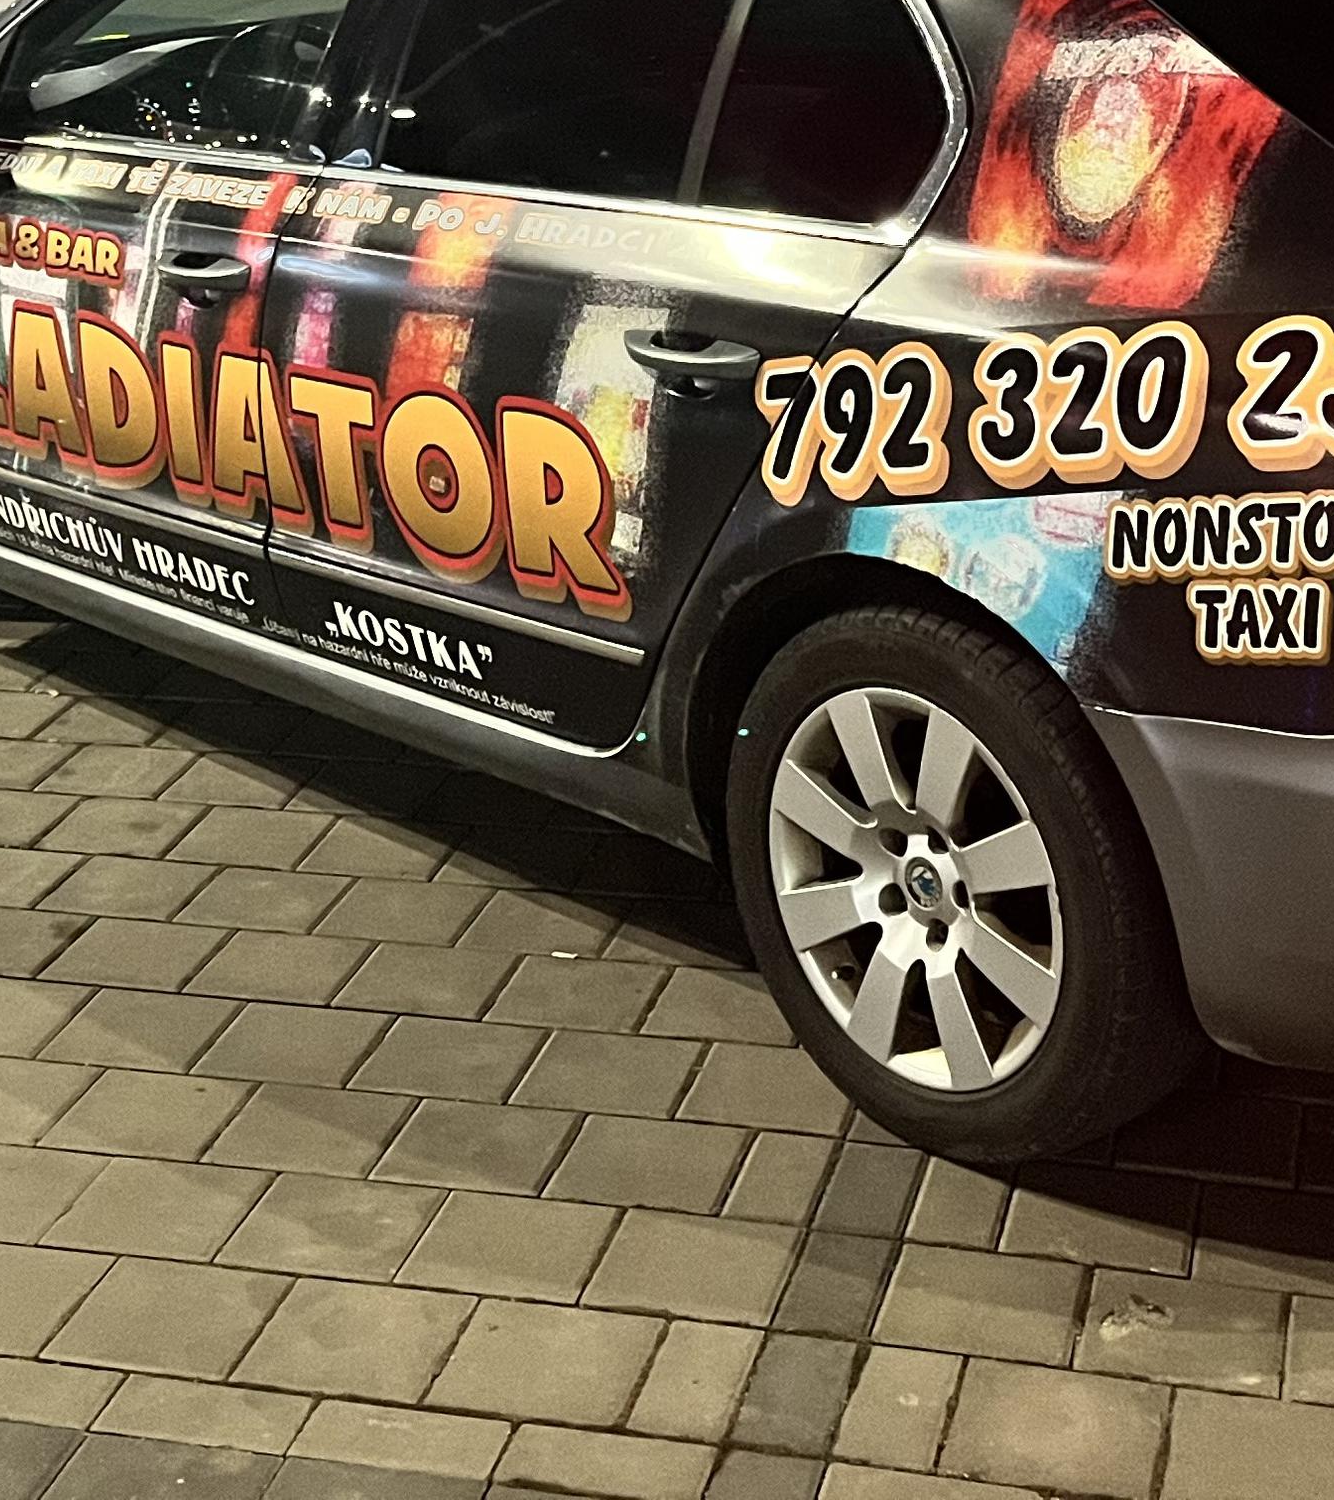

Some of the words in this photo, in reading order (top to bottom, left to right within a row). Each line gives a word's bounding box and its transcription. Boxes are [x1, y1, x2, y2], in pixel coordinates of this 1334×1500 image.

[70, 158, 128, 189] TAXI
[127, 160, 170, 193] TĚ
[167, 173, 275, 207] ZAVEZE
[283, 187, 315, 214] K
[313, 187, 393, 224] NÁM
[412, 199, 466, 231] PO
[474, 212, 507, 238] J.
[516, 213, 658, 255] HRADCI
[14, 221, 42, 262] &
[44, 227, 122, 279] BAR
[757, 346, 948, 498] 792
[970, 325, 1207, 483] 320
[132, 537, 255, 606] HRADEC
[1189, 583, 1331, 663] TAXI
